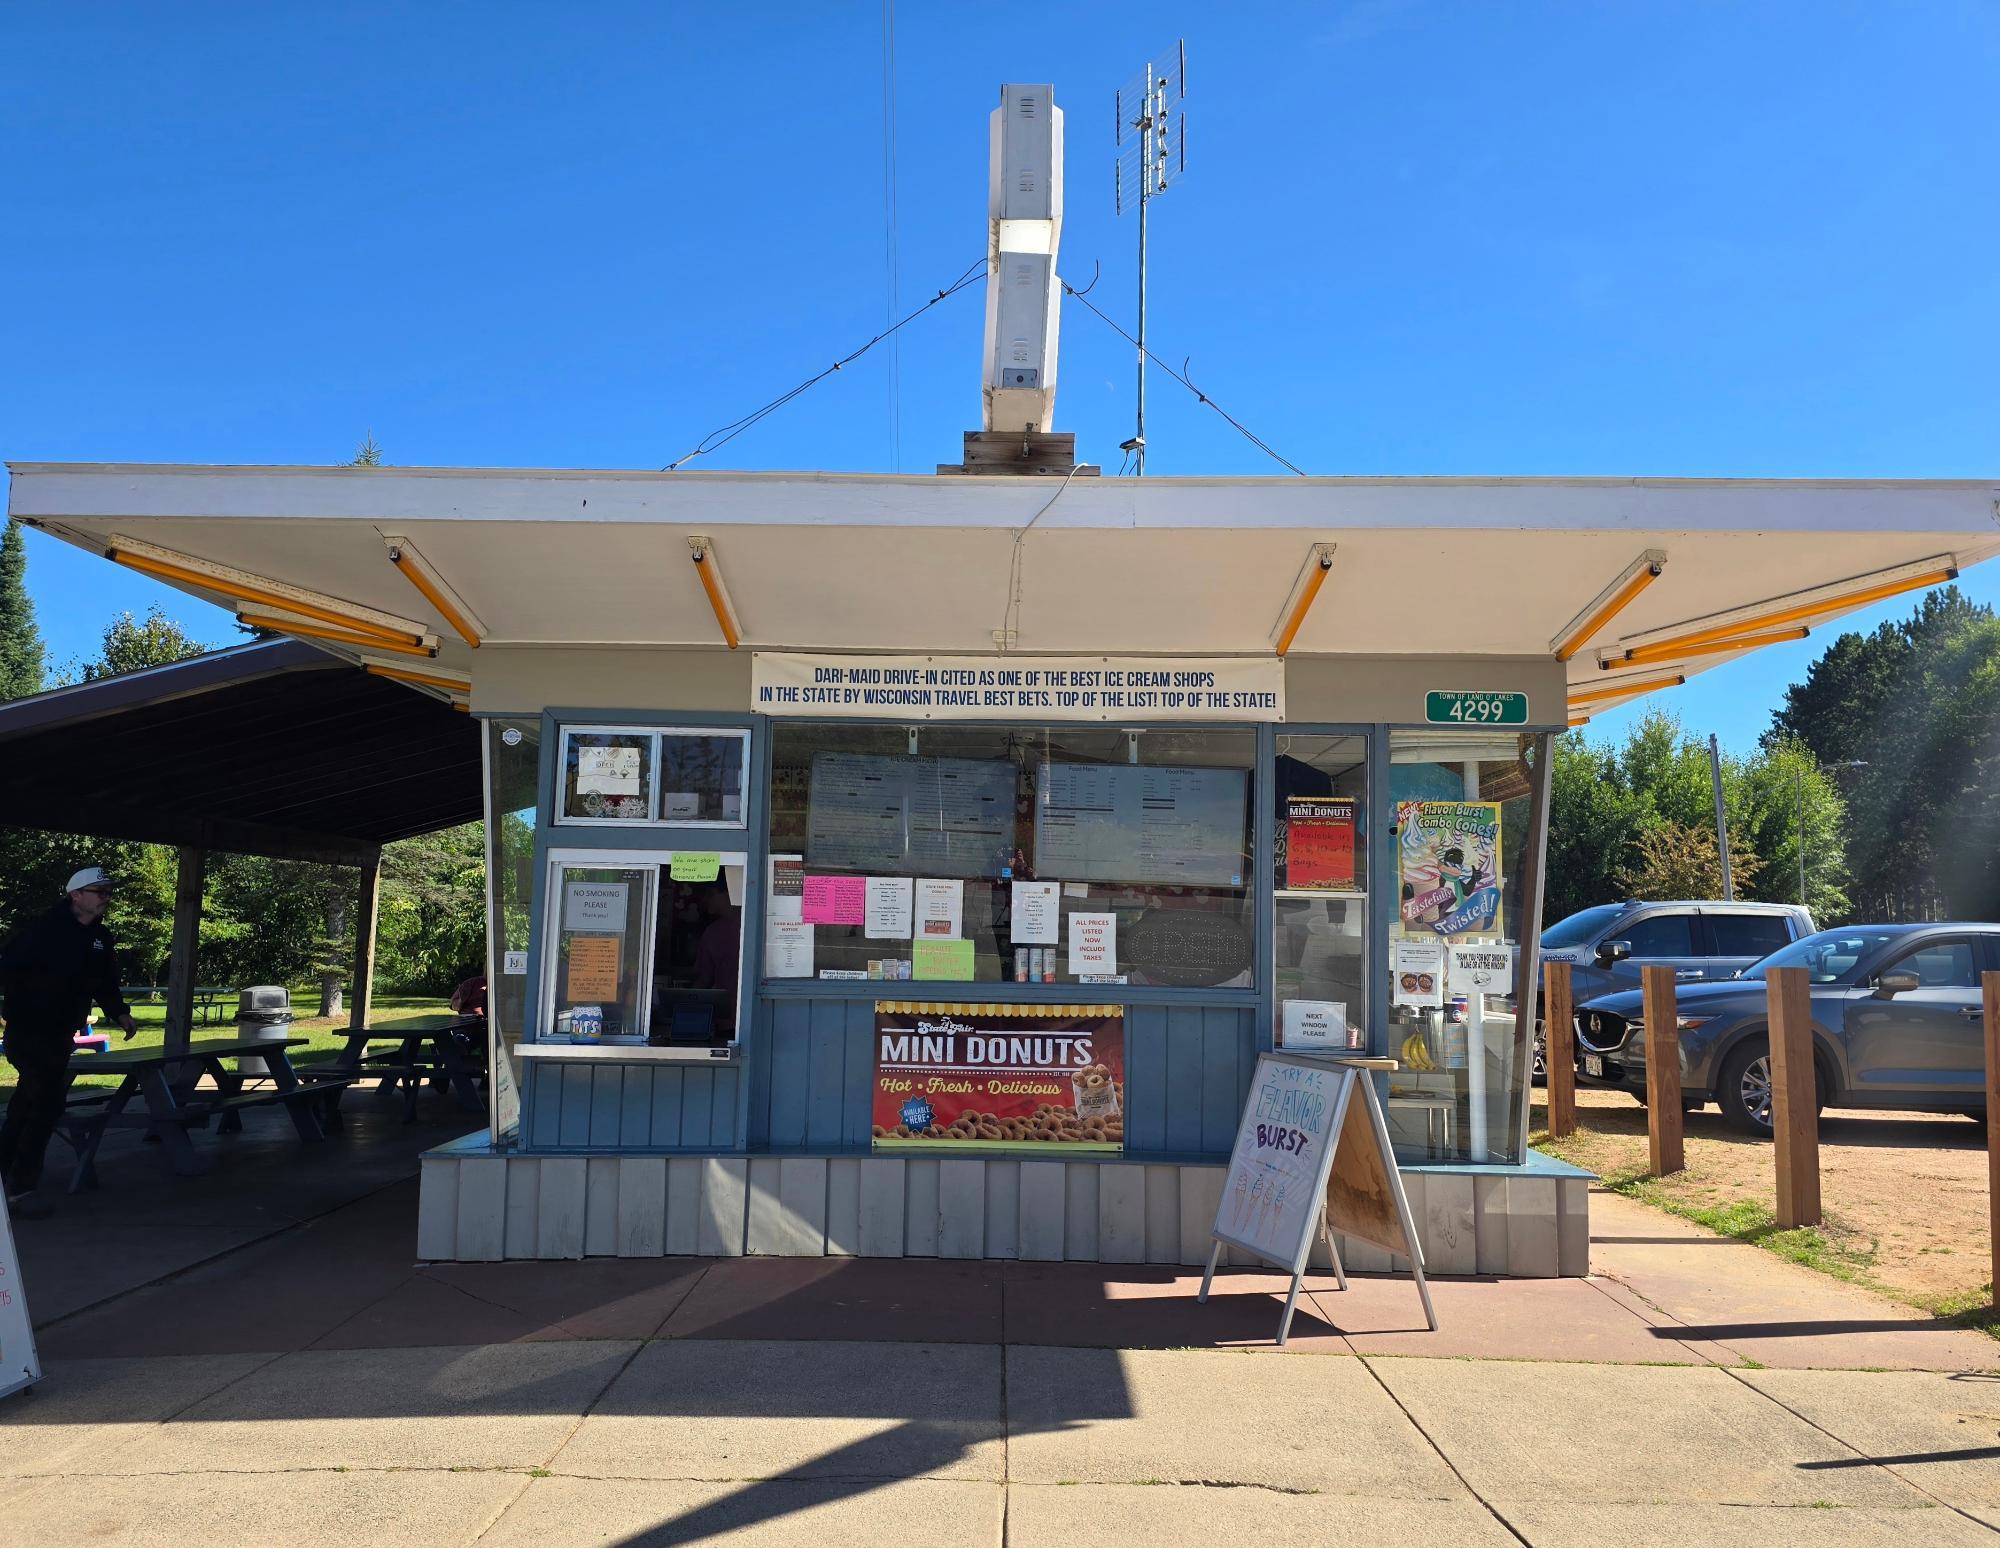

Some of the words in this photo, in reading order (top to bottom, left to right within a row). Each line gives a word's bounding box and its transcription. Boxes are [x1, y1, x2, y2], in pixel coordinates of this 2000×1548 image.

[815, 667, 880, 684] DARI-MAID
[884, 669, 937, 685] DRIVE-IN
[941, 670, 975, 685] CITED
[979, 671, 994, 686] AS
[998, 671, 1022, 686] ONE
[1026, 671, 1040, 686] OF
[1044, 671, 1066, 686] THE
[1070, 671, 1101, 687] BEST
[1104, 672, 1124, 687] ICE
[1127, 672, 1170, 687] CREAM
[1174, 672, 1215, 688] SHOPS
[760, 686, 773, 702] IN
[776, 687, 799, 702] THE
[803, 687, 840, 703] STATE
[844, 688, 860, 703] BY
[864, 688, 931, 705] WISCONSIN
[935, 690, 981, 706] TRAVEL
[984, 690, 1015, 706] BEST
[1018, 691, 1052, 707] BETS.
[1056, 691, 1079, 707] TOP
[1082, 691, 1097, 707] OF
[1100, 692, 1124, 707] THE
[1127, 692, 1157, 707] LIST!
[1161, 692, 1184, 708] TOP
[1187, 692, 1203, 708] OF
[1206, 692, 1229, 708] THE
[1233, 692, 1276, 708] STATE!
[1468, 693, 1483, 701] LAND
[1449, 700, 1503, 721] 4299
[1289, 807, 1312, 816] MINI
[1314, 808, 1352, 817] DONUTS
[1398, 803, 1419, 821] NEW!
[1424, 804, 1455, 815] Flavor
[1456, 804, 1485, 818] Burst
[1418, 816, 1452, 828] Combo
[1455, 817, 1499, 839] Cones!
[573, 889, 585, 897] NO
[586, 889, 620, 898] SMOKING
[584, 901, 608, 909] PLEASE
[1403, 888, 1452, 918] Tastefully
[1435, 894, 1496, 934] Twisted!
[1456, 952, 1468, 961] THANK
[917, 1020, 947, 1034] State
[881, 1035, 955, 1063] MINI
[966, 1036, 1093, 1065] DONUTS
[880, 1077, 913, 1093] Hot
[926, 1078, 975, 1094] Fresh
[987, 1079, 1062, 1095] Delicious
[1281, 1067, 1302, 1083] TRY
[1305, 1071, 1314, 1087] A
[903, 1105, 930, 1117] AVAILABLE
[1256, 1085, 1327, 1133] FLAVOR
[909, 1114, 927, 1125] HERE
[1256, 1124, 1309, 1157] BURST
